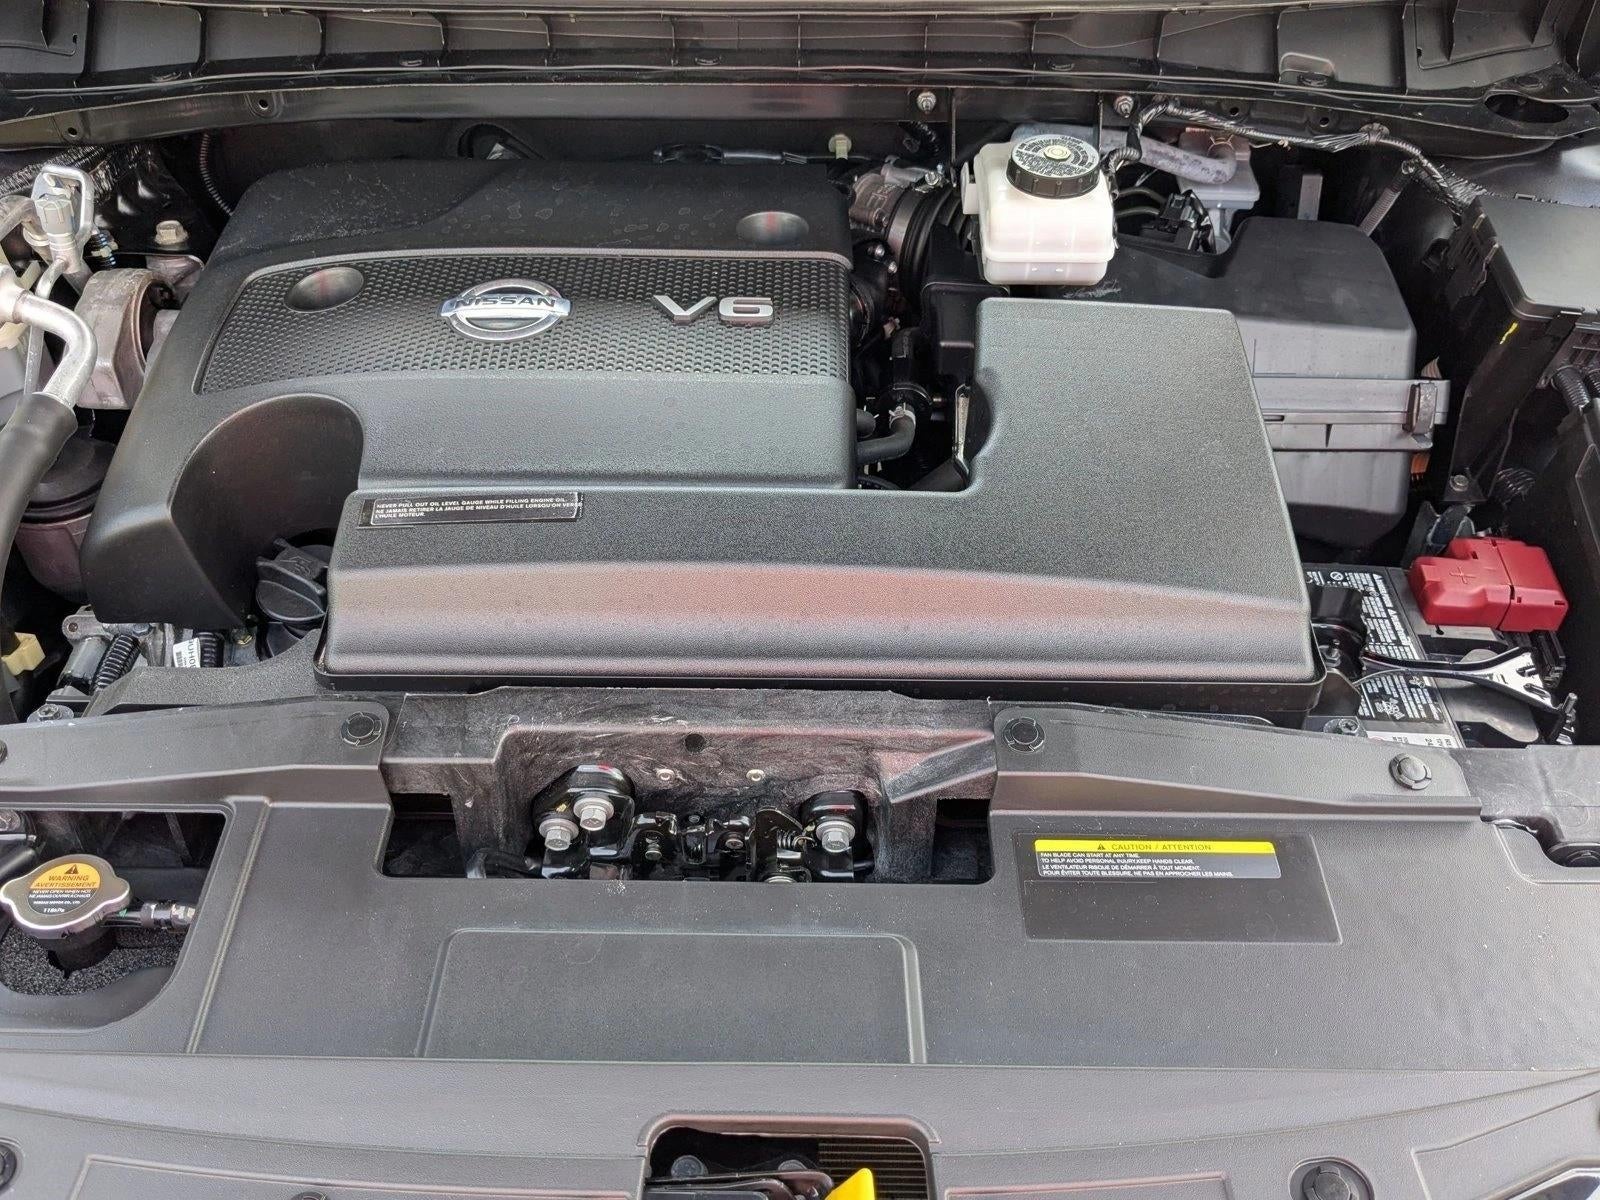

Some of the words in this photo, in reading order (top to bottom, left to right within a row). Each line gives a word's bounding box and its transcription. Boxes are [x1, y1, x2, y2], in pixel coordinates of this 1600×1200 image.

[454, 295, 557, 309] NISSAN
[652, 294, 774, 327] V6
[48, 874, 90, 882] WARNING
